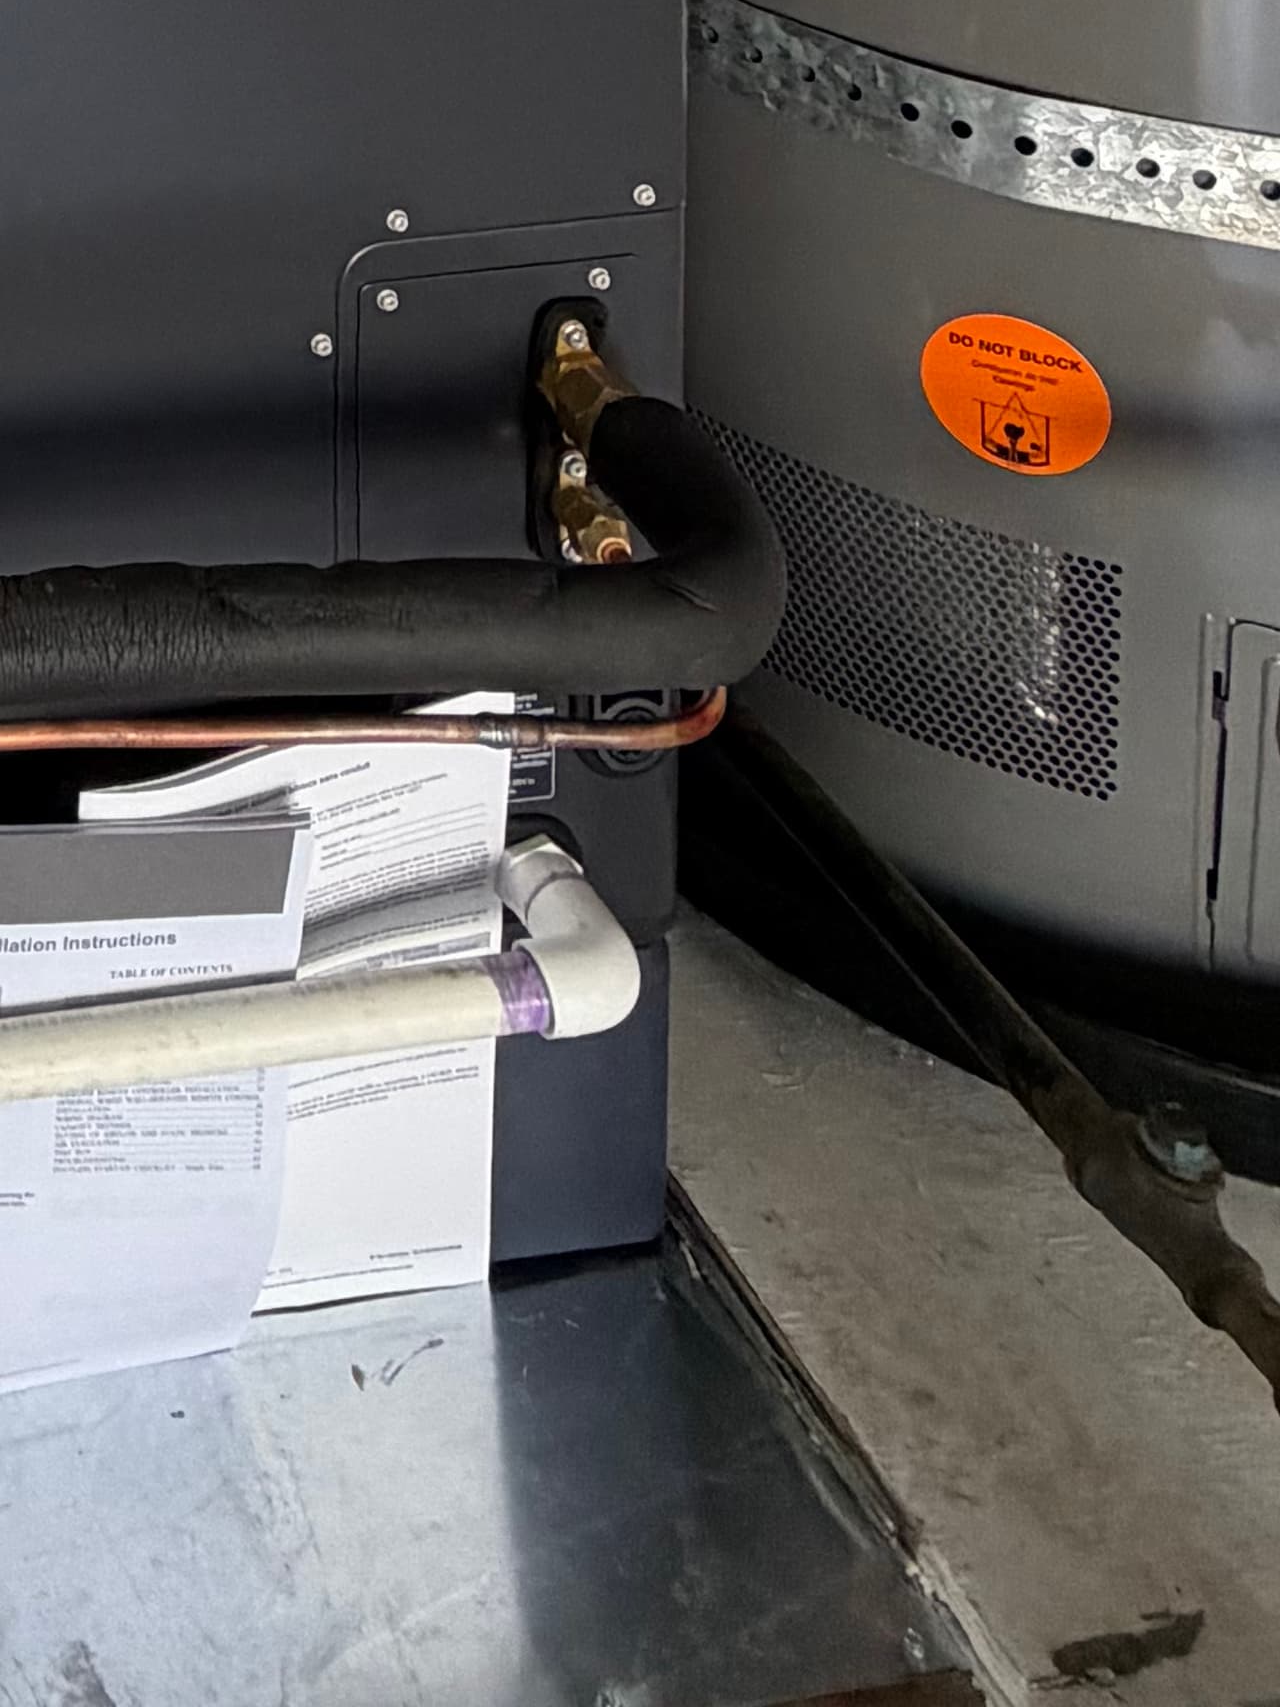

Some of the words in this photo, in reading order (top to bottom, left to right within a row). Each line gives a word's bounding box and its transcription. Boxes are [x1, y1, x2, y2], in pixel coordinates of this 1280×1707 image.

[949, 331, 973, 347] DO
[978, 339, 1014, 358] NOT
[1019, 349, 1083, 373] BLOCK
[62, 932, 178, 951] Instructions
[110, 969, 147, 980] TABLE
[151, 967, 167, 978] OF
[170, 963, 233, 977] CONTENTS
